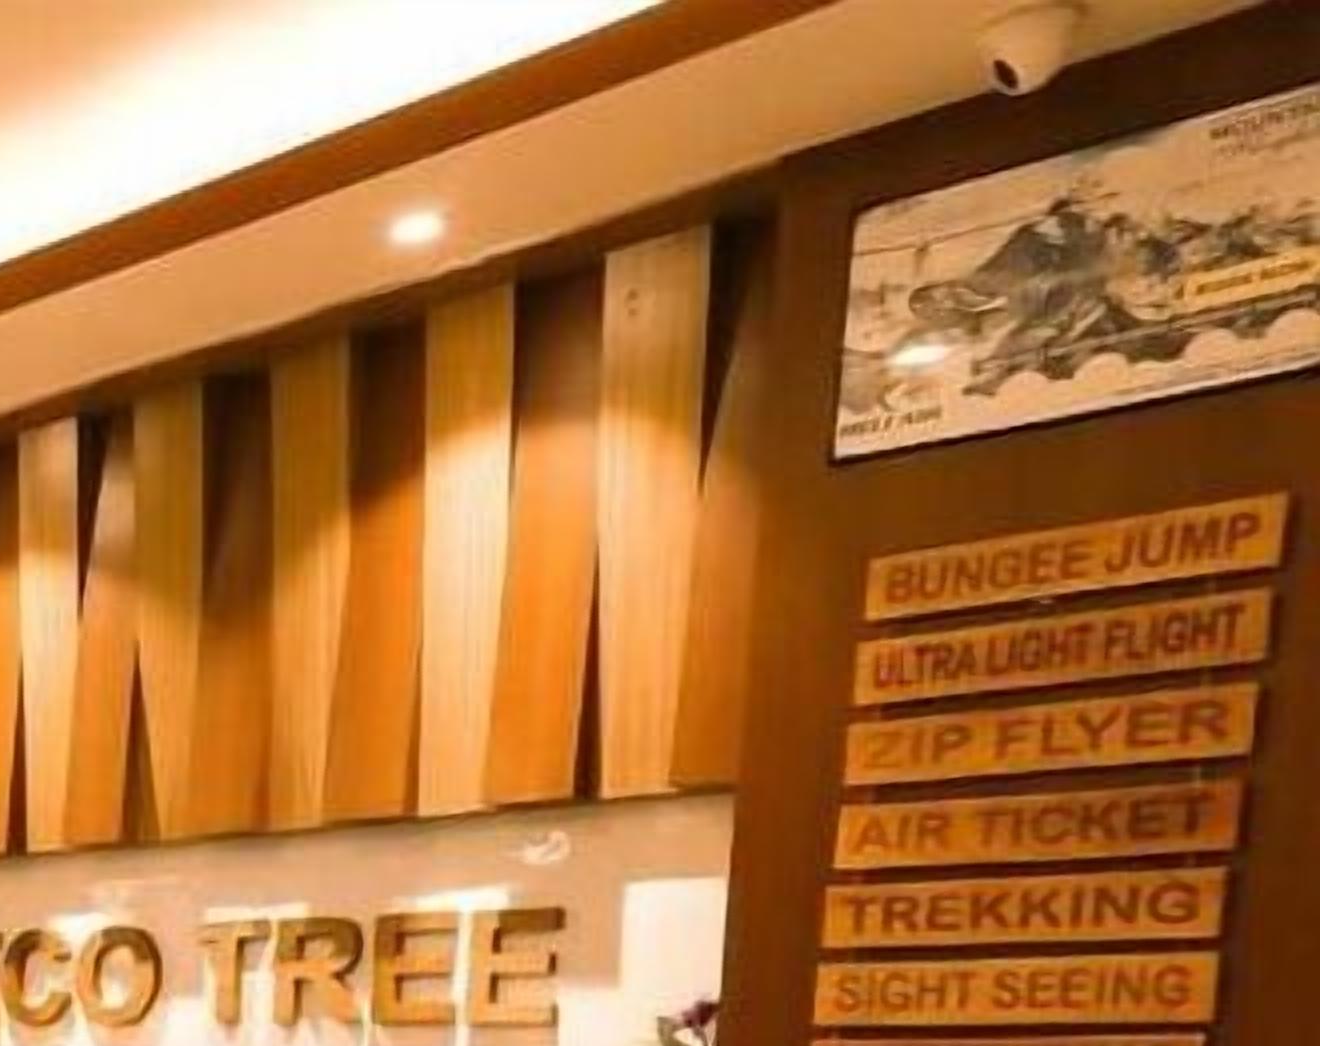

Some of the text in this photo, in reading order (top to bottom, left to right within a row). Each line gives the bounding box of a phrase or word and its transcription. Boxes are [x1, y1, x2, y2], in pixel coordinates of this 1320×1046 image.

[884, 511, 1260, 603] BUNGEE JUMP
[872, 603, 1248, 691] ULTRA LIGHT FLIGHT
[862, 700, 1231, 770] ZIP FLYER
[846, 792, 1214, 853] AIR TICKET
[845, 880, 1203, 935] TREKKING
[198, 906, 567, 1028] TREE
[834, 964, 1194, 1013] SIGHT SEEING
